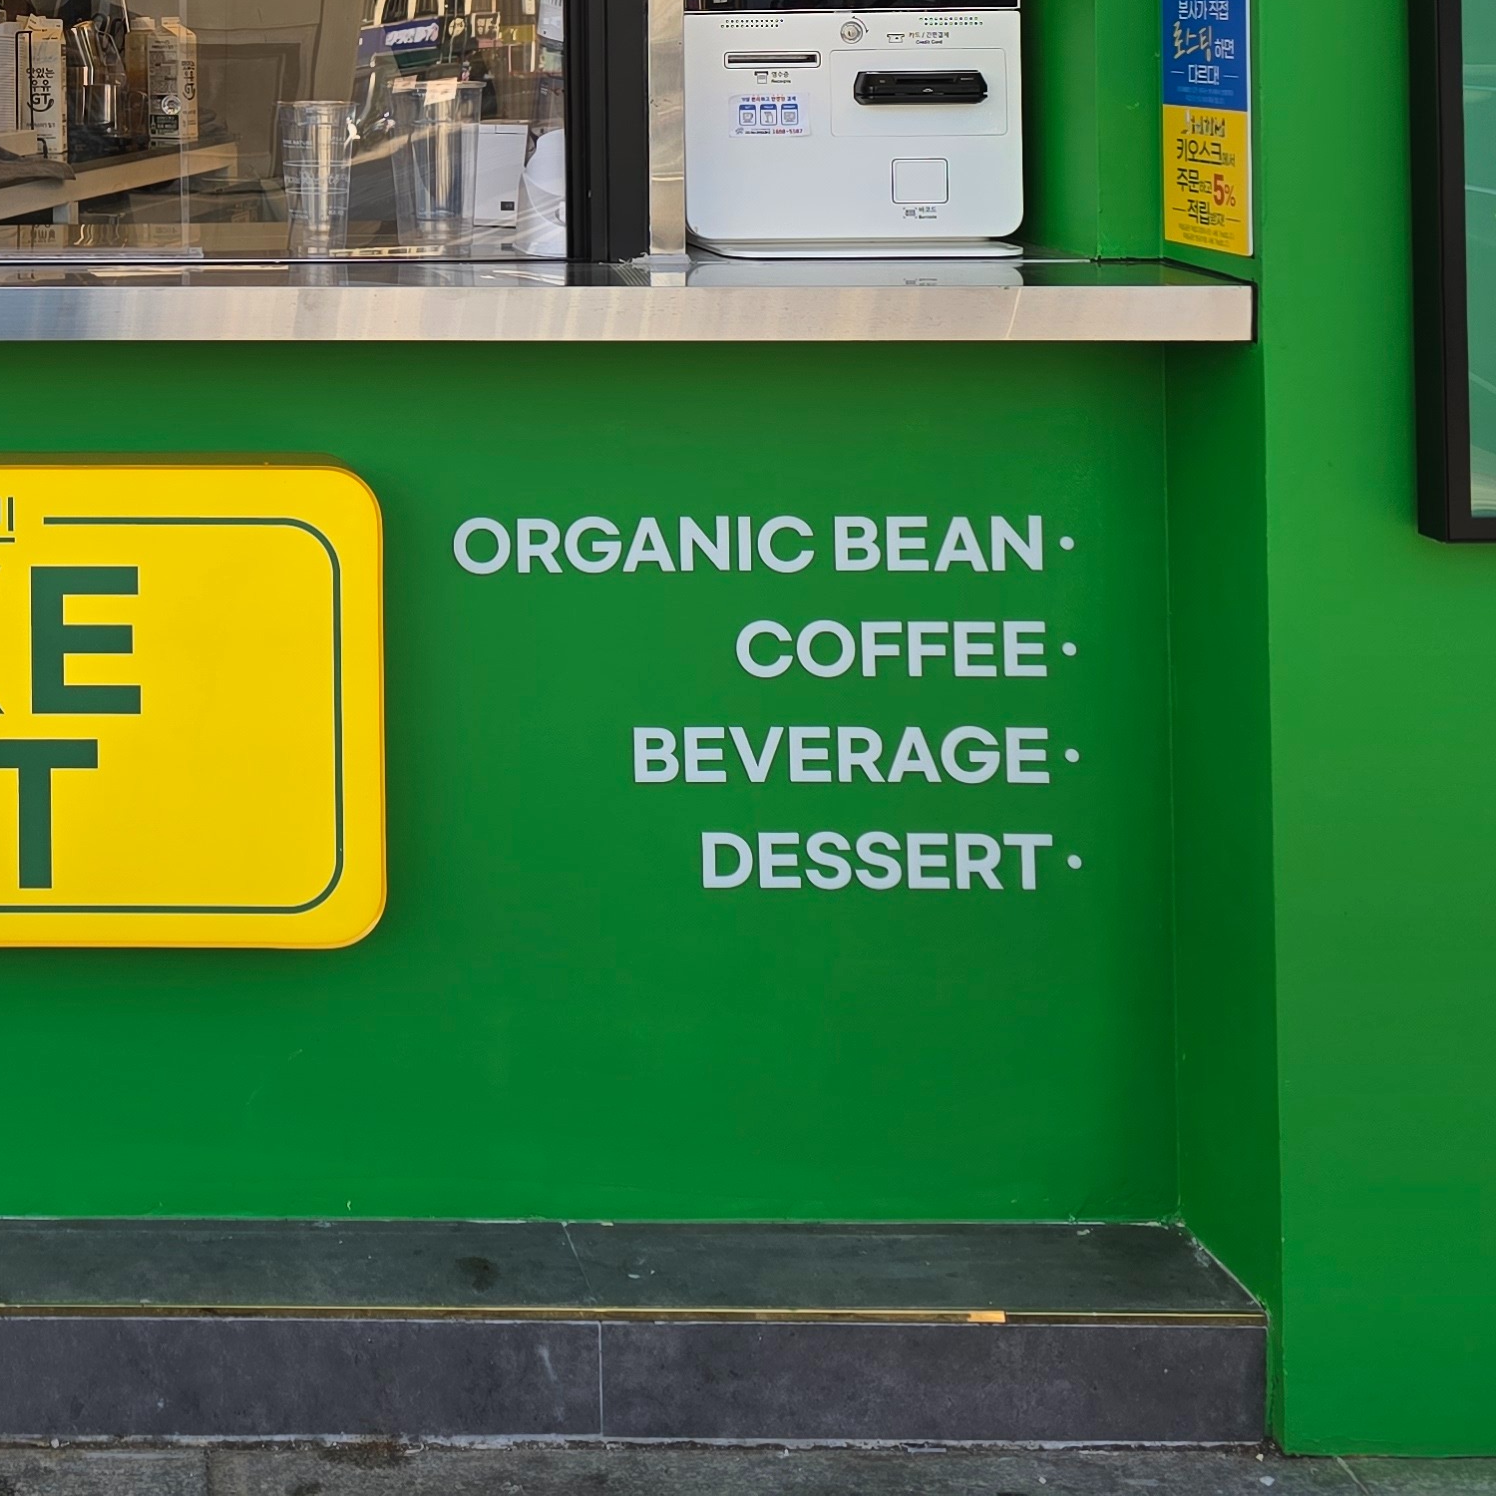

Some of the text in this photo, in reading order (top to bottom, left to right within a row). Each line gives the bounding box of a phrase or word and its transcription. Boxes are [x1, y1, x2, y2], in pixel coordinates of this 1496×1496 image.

[1214, 173, 1236, 207] 5%
[453, 515, 1043, 574] ORGANIC BEAN
[736, 620, 1047, 678] COFFEE
[633, 726, 1050, 785] BEVERAGE
[701, 831, 1053, 890] DESSERT
